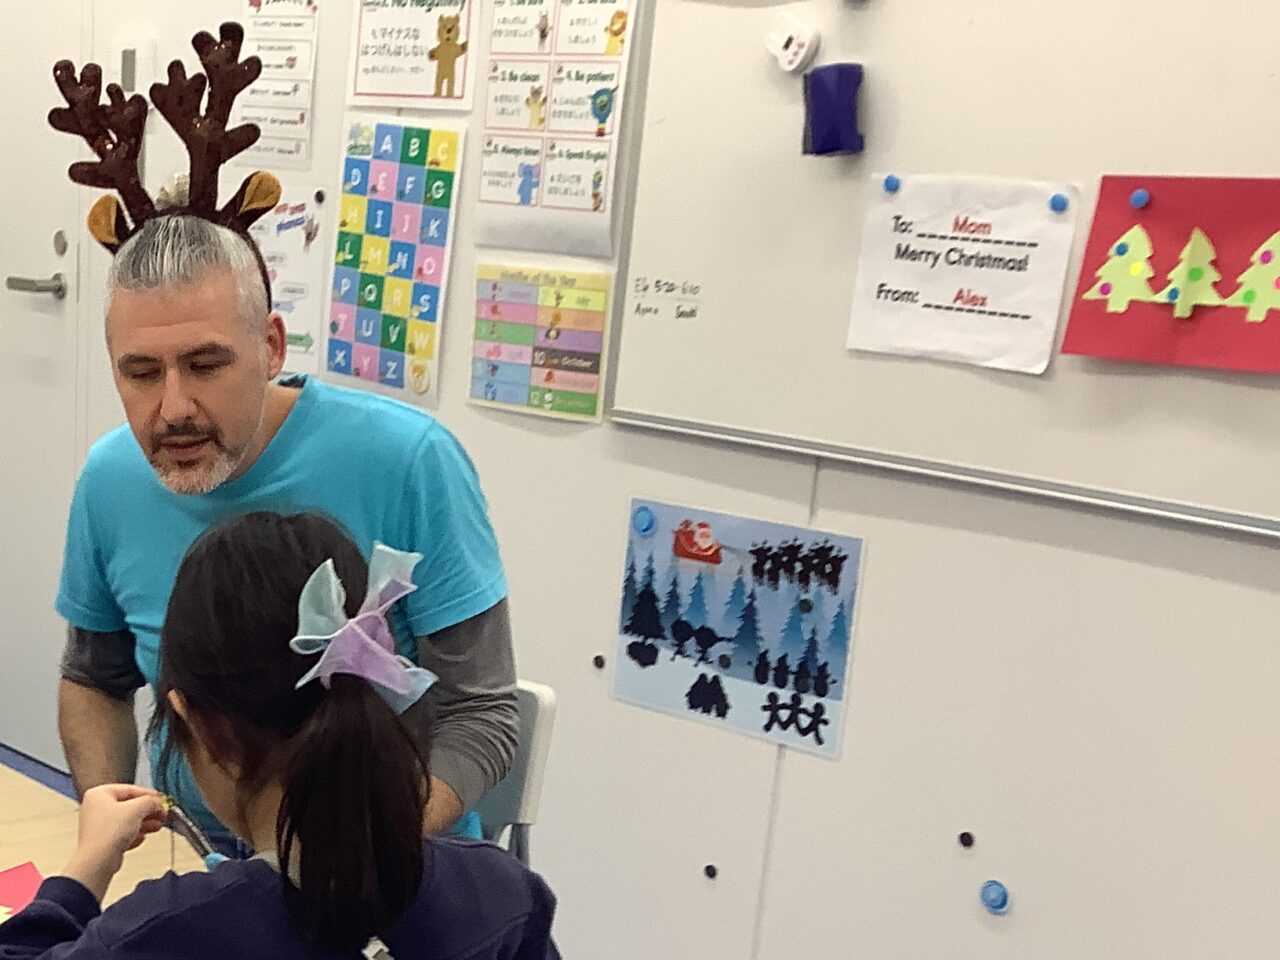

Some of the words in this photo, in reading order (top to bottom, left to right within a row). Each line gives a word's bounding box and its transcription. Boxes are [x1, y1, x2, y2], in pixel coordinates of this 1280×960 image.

[380, 134, 393, 153] A
[408, 138, 420, 157] B
[351, 168, 361, 186] D
[377, 172, 387, 191] E
[405, 176, 415, 194] F
[431, 180, 445, 199] G
[375, 209, 384, 229] I
[402, 214, 410, 233] J
[428, 218, 441, 238] K
[892, 215, 914, 233] To:
[952, 215, 992, 235] Mom
[344, 240, 354, 259] L
[423, 257, 436, 275] O
[894, 243, 942, 269] Merry
[340, 277, 351, 296] P
[364, 284, 377, 303] Q
[420, 294, 431, 313] S
[876, 283, 920, 304] From:
[952, 287, 989, 307] Alex
[362, 320, 374, 337] U
[389, 325, 400, 343] V
[414, 330, 429, 350] W
[335, 349, 346, 367] X
[361, 356, 371, 372] Y
[386, 361, 398, 380] Z
